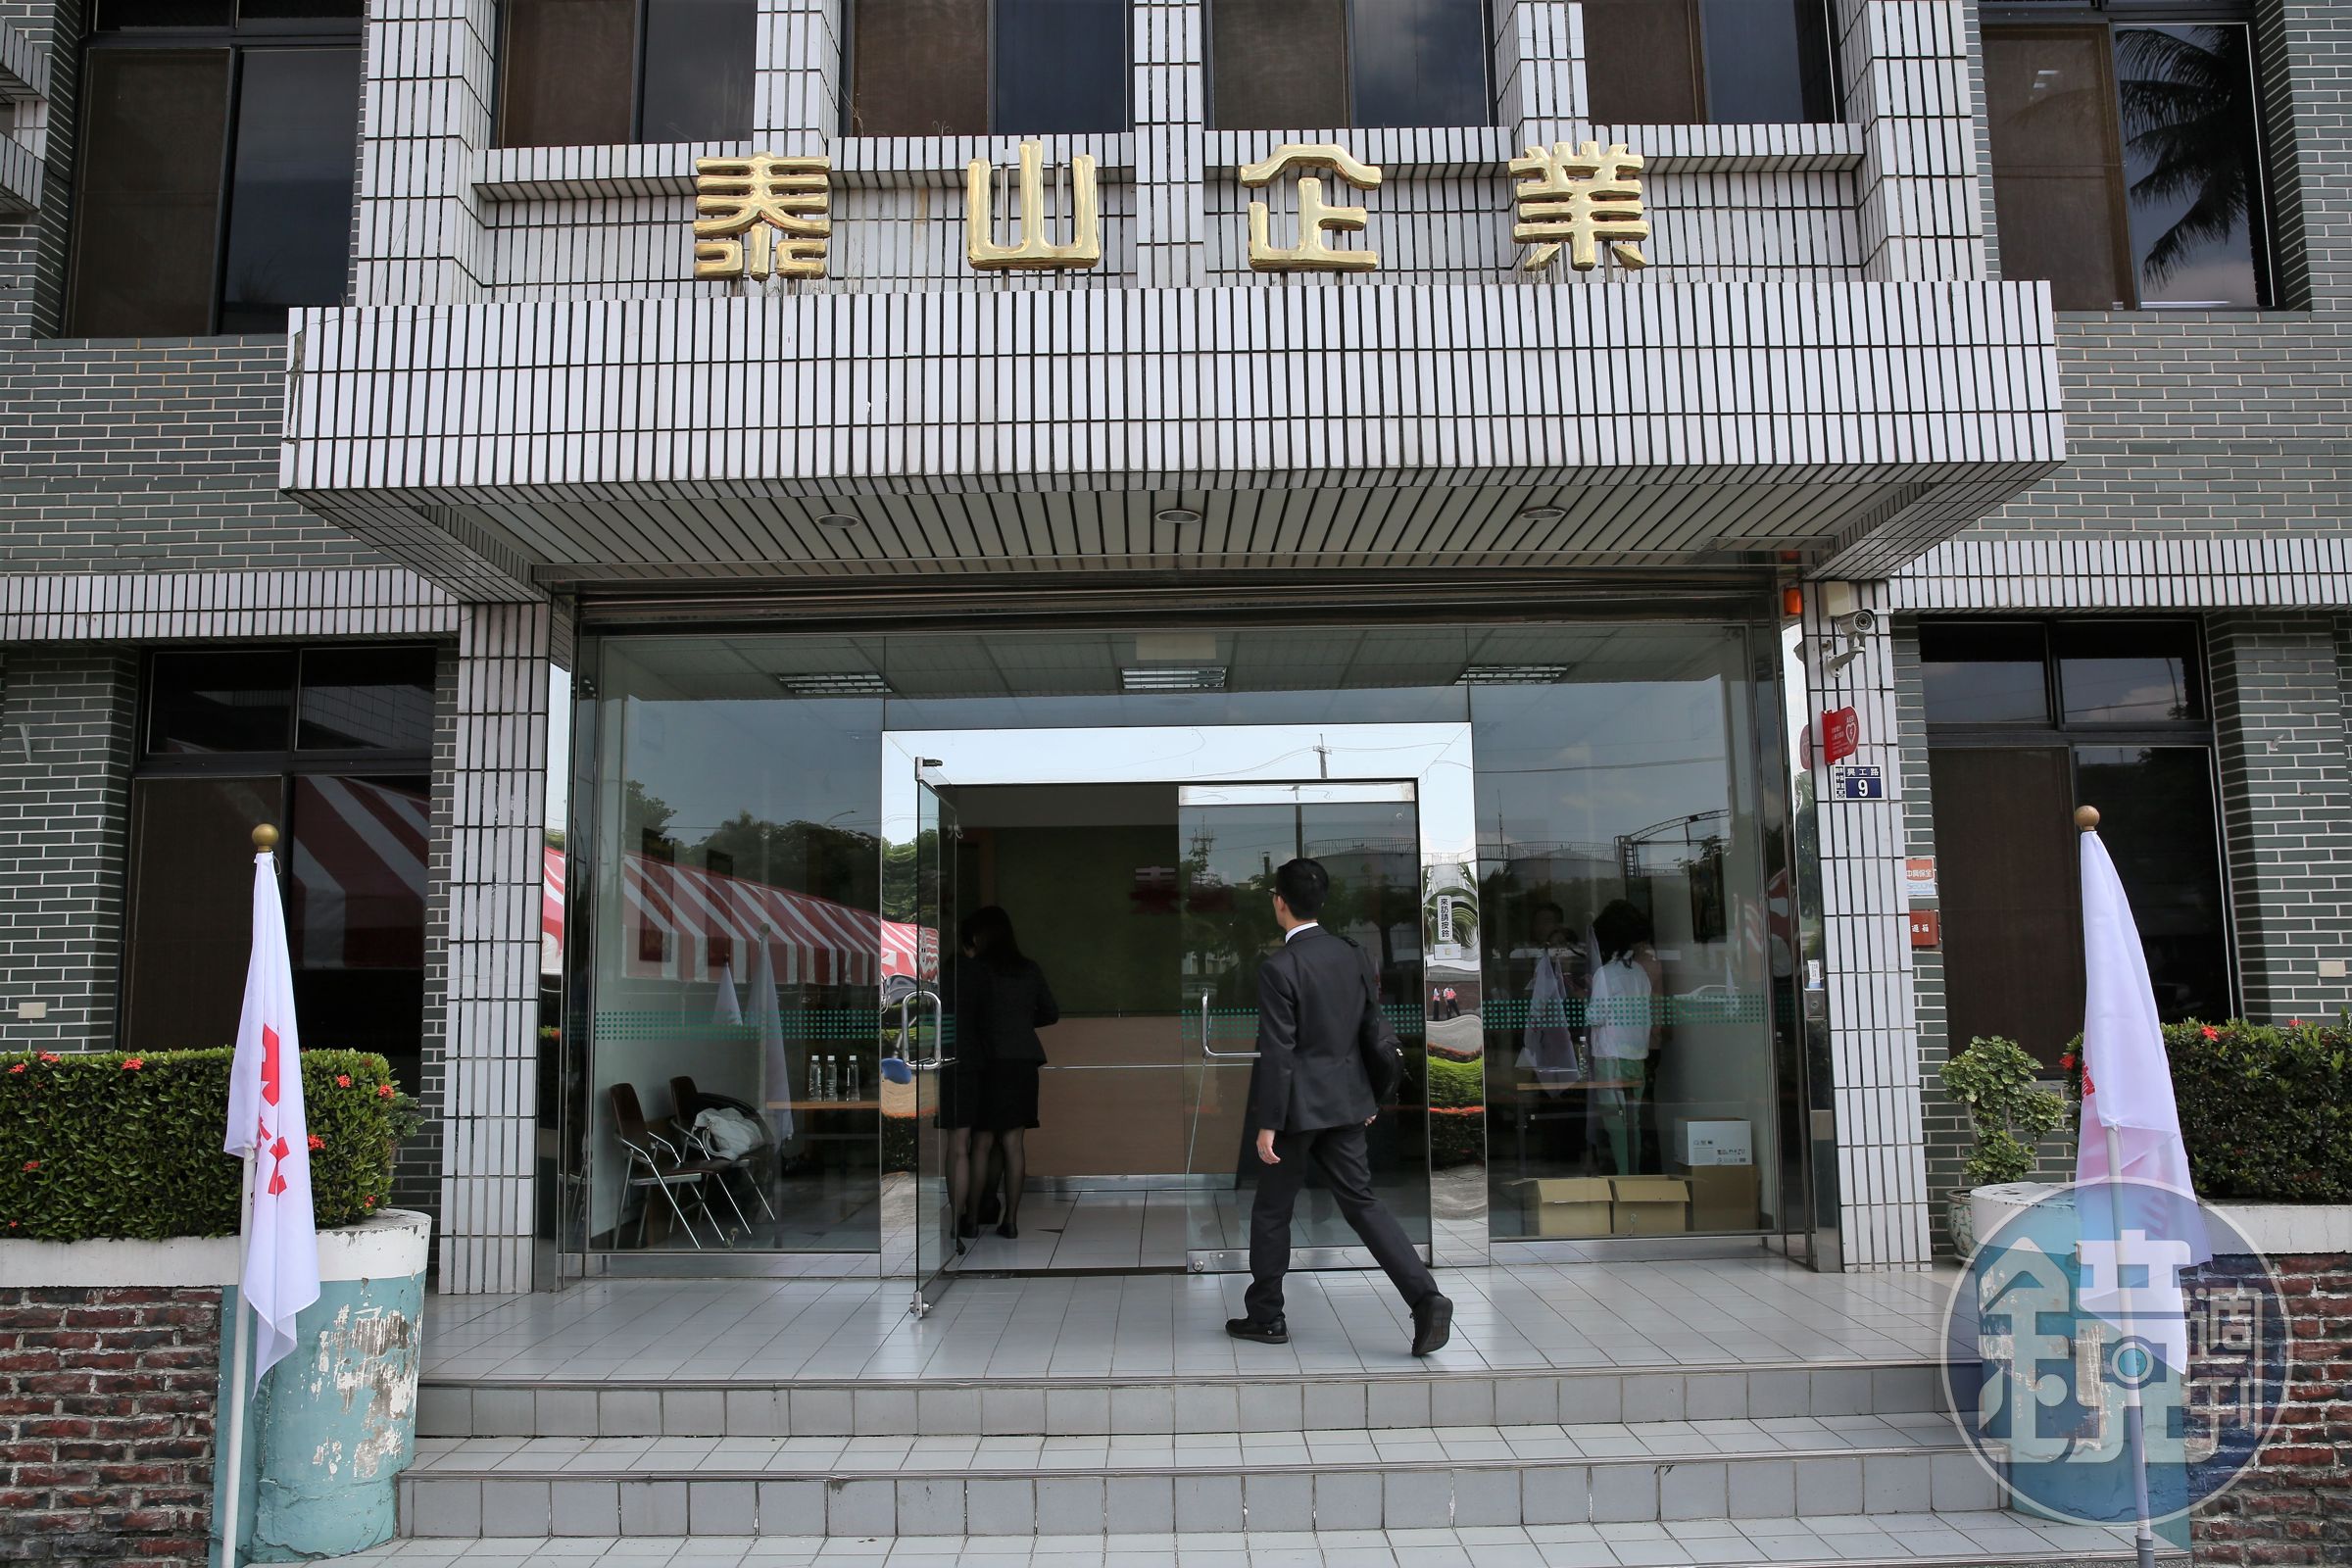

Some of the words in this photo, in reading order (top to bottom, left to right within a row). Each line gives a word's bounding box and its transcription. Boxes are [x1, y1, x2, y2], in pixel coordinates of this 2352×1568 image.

[694, 140, 1648, 280] 泰山企業
[1847, 767, 1879, 776] 興工路
[1857, 779, 1869, 797] 9
[1906, 869, 1933, 878] 中興保全
[1441, 899, 1449, 937] 來訪請按鈴
